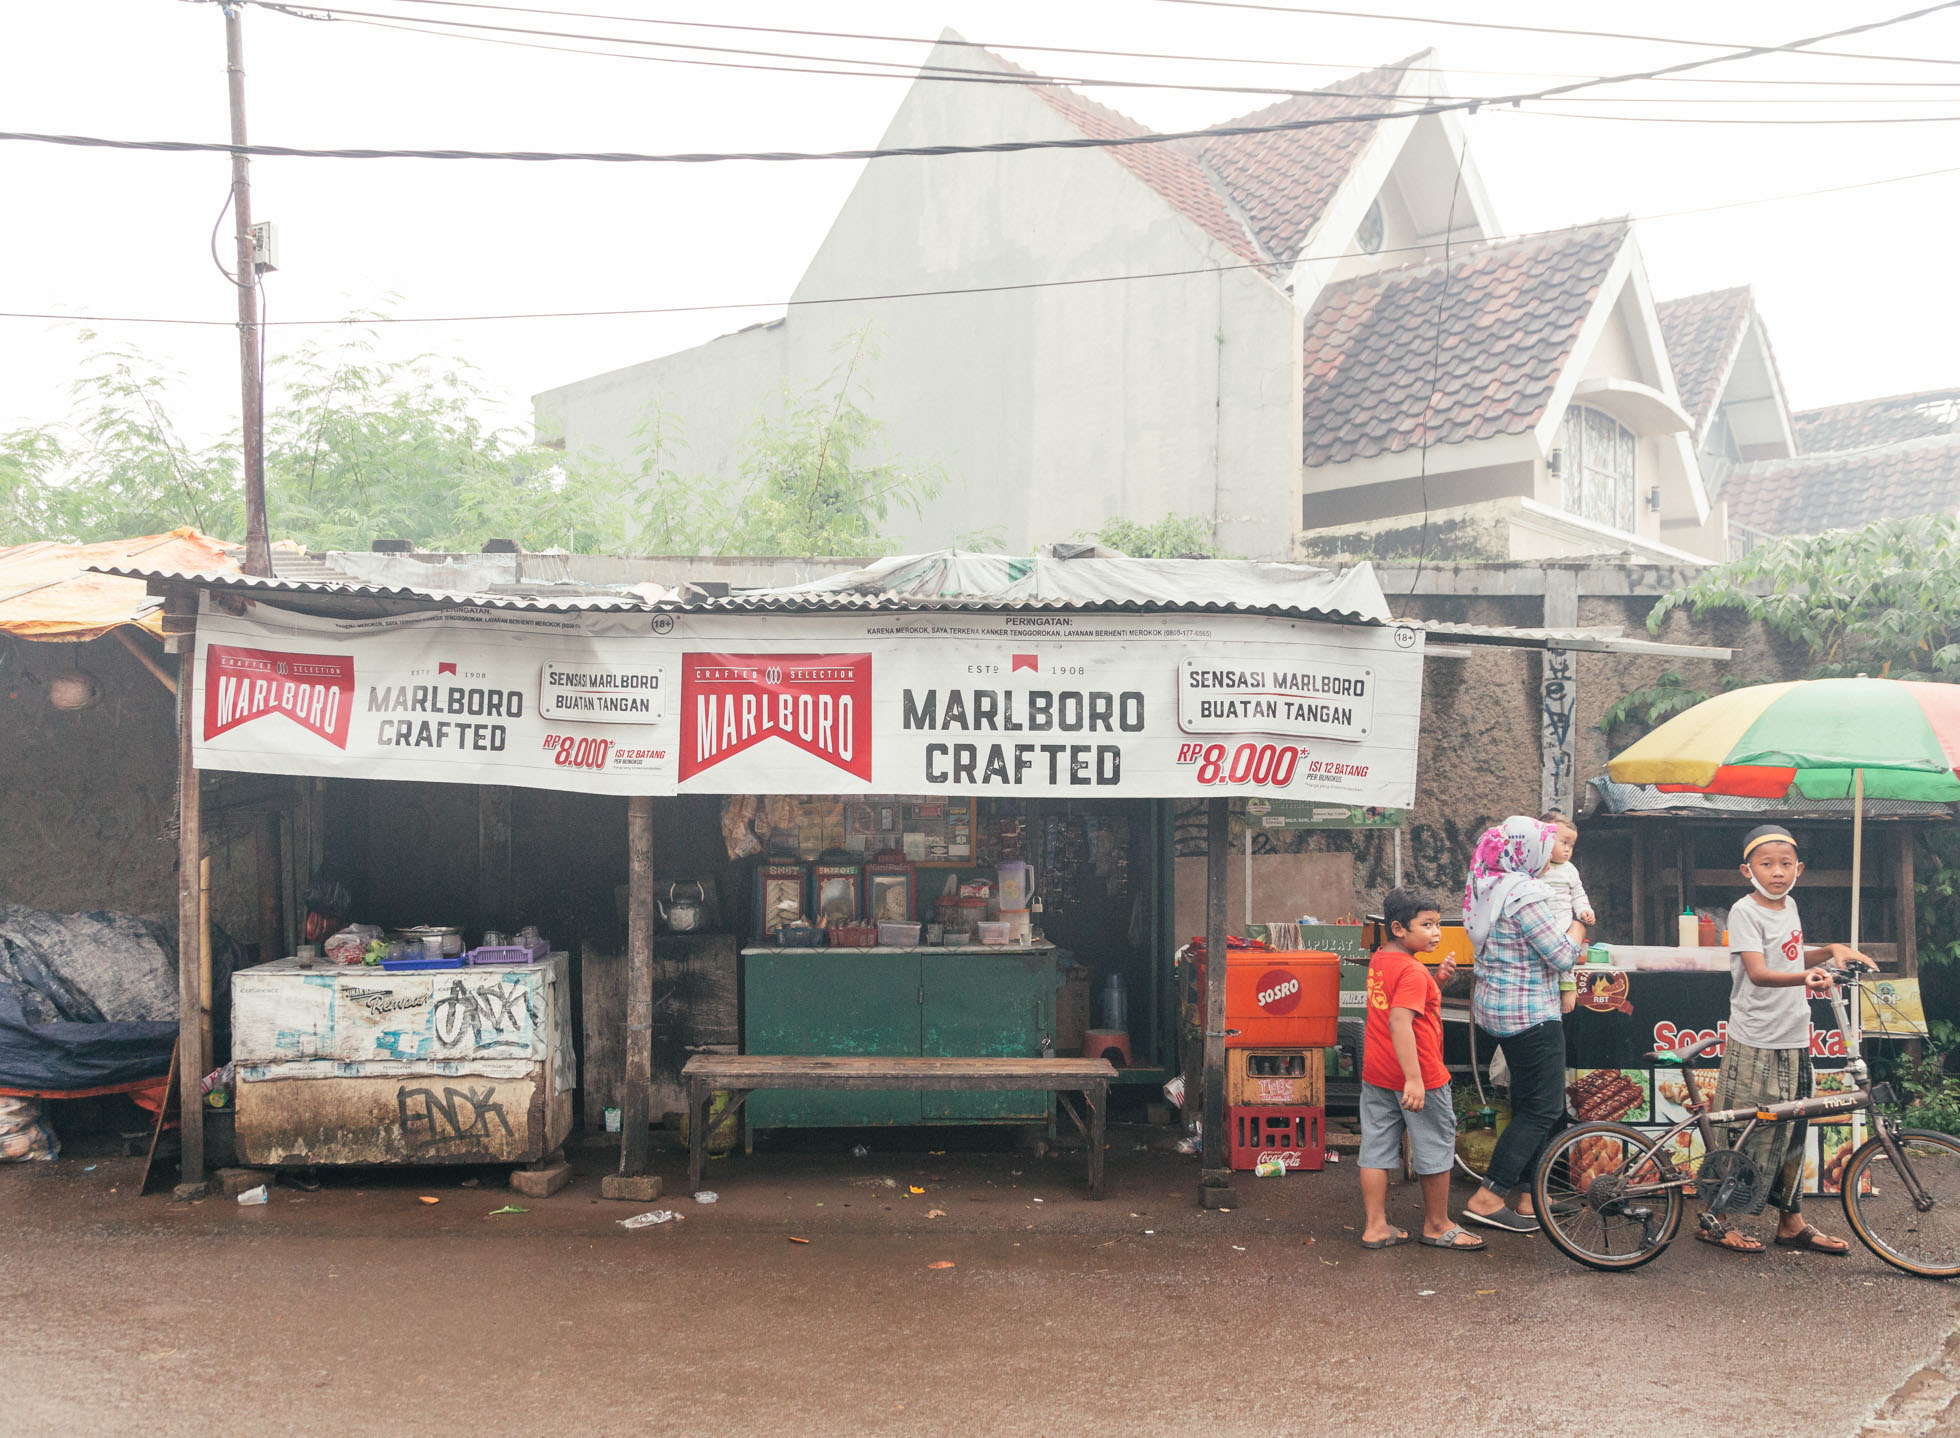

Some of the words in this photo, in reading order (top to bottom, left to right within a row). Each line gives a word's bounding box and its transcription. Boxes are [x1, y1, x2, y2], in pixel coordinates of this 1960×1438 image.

[535, 620, 560, 628] MEROKOK
[653, 619, 671, 628] 18+
[1005, 617, 1073, 626] PERINGATAN:
[896, 627, 930, 635] MEROKOK,
[981, 628, 1008, 636] KANKER
[1095, 629, 1128, 637] BERHENTI
[1129, 629, 1163, 637] MEROKOK
[1397, 633, 1413, 642] 18+
[221, 658, 271, 670] CRAFTED
[293, 665, 341, 674] SELECTION
[696, 670, 758, 679] CRAFTED
[790, 671, 854, 679] SELECTION
[1052, 667, 1085, 675] 1908
[549, 671, 587, 688] SENSASI
[589, 674, 659, 690] MARLBORO
[1189, 671, 1266, 688] SENSASI
[1273, 672, 1365, 697] MARLBORO
[217, 676, 340, 735] MARLBORO
[367, 685, 524, 718] MARLBORO
[555, 694, 595, 711] BUATAN
[596, 697, 650, 713] TANGAN
[903, 689, 1145, 732] MARLBORO
[1201, 700, 1277, 718] BUATAN
[1284, 702, 1352, 726] TANGAN
[377, 719, 507, 751] CRAFTED
[697, 694, 853, 763] MARLBORO
[614, 749, 625, 758] ISI
[626, 749, 634, 759] 12
[635, 750, 666, 760] BATANG
[925, 743, 1121, 785] CRAFTED
[1308, 761, 1321, 773] ISI
[1324, 762, 1334, 774] 12
[1334, 763, 1369, 777] BATANG
[1306, 773, 1318, 781] PER
[1258, 979, 1299, 1007] SOSRO
